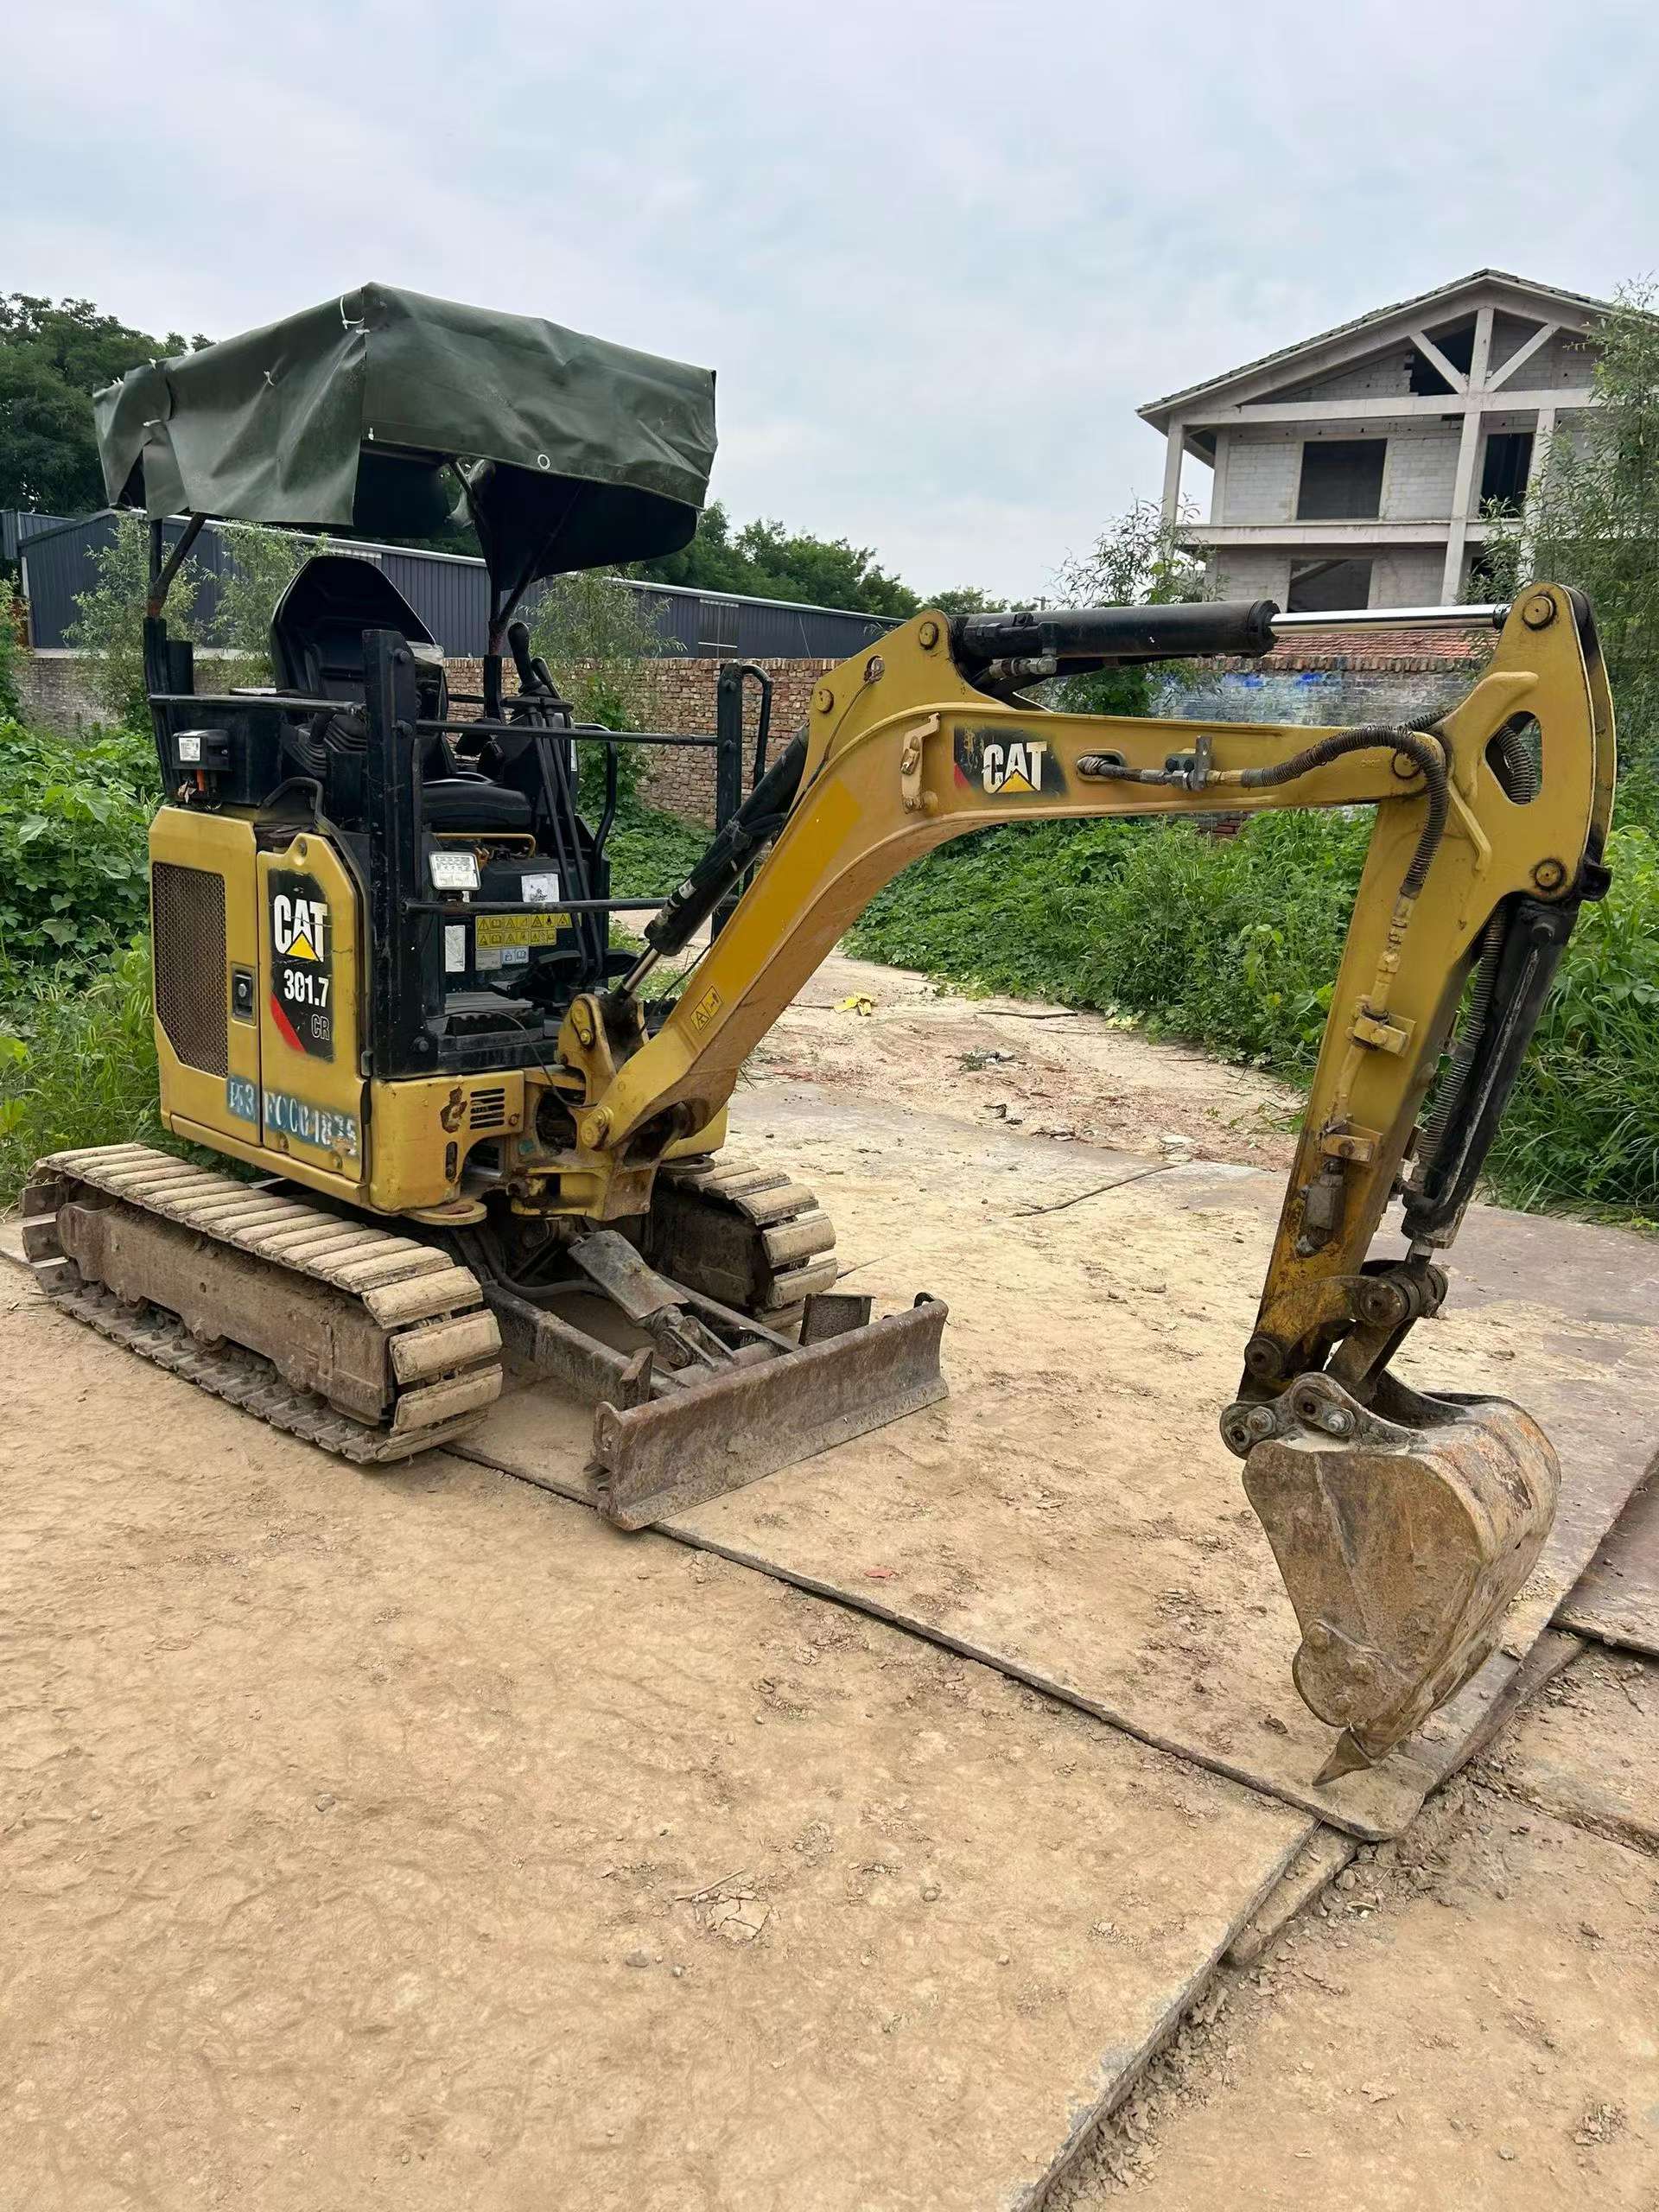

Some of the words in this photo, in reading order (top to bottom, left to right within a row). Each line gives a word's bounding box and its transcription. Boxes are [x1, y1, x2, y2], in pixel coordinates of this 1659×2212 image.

[982, 741, 1048, 794] CAT
[273, 893, 329, 963] CAT
[283, 969, 329, 1008] 301.7
[311, 1013, 331, 1041] CR
